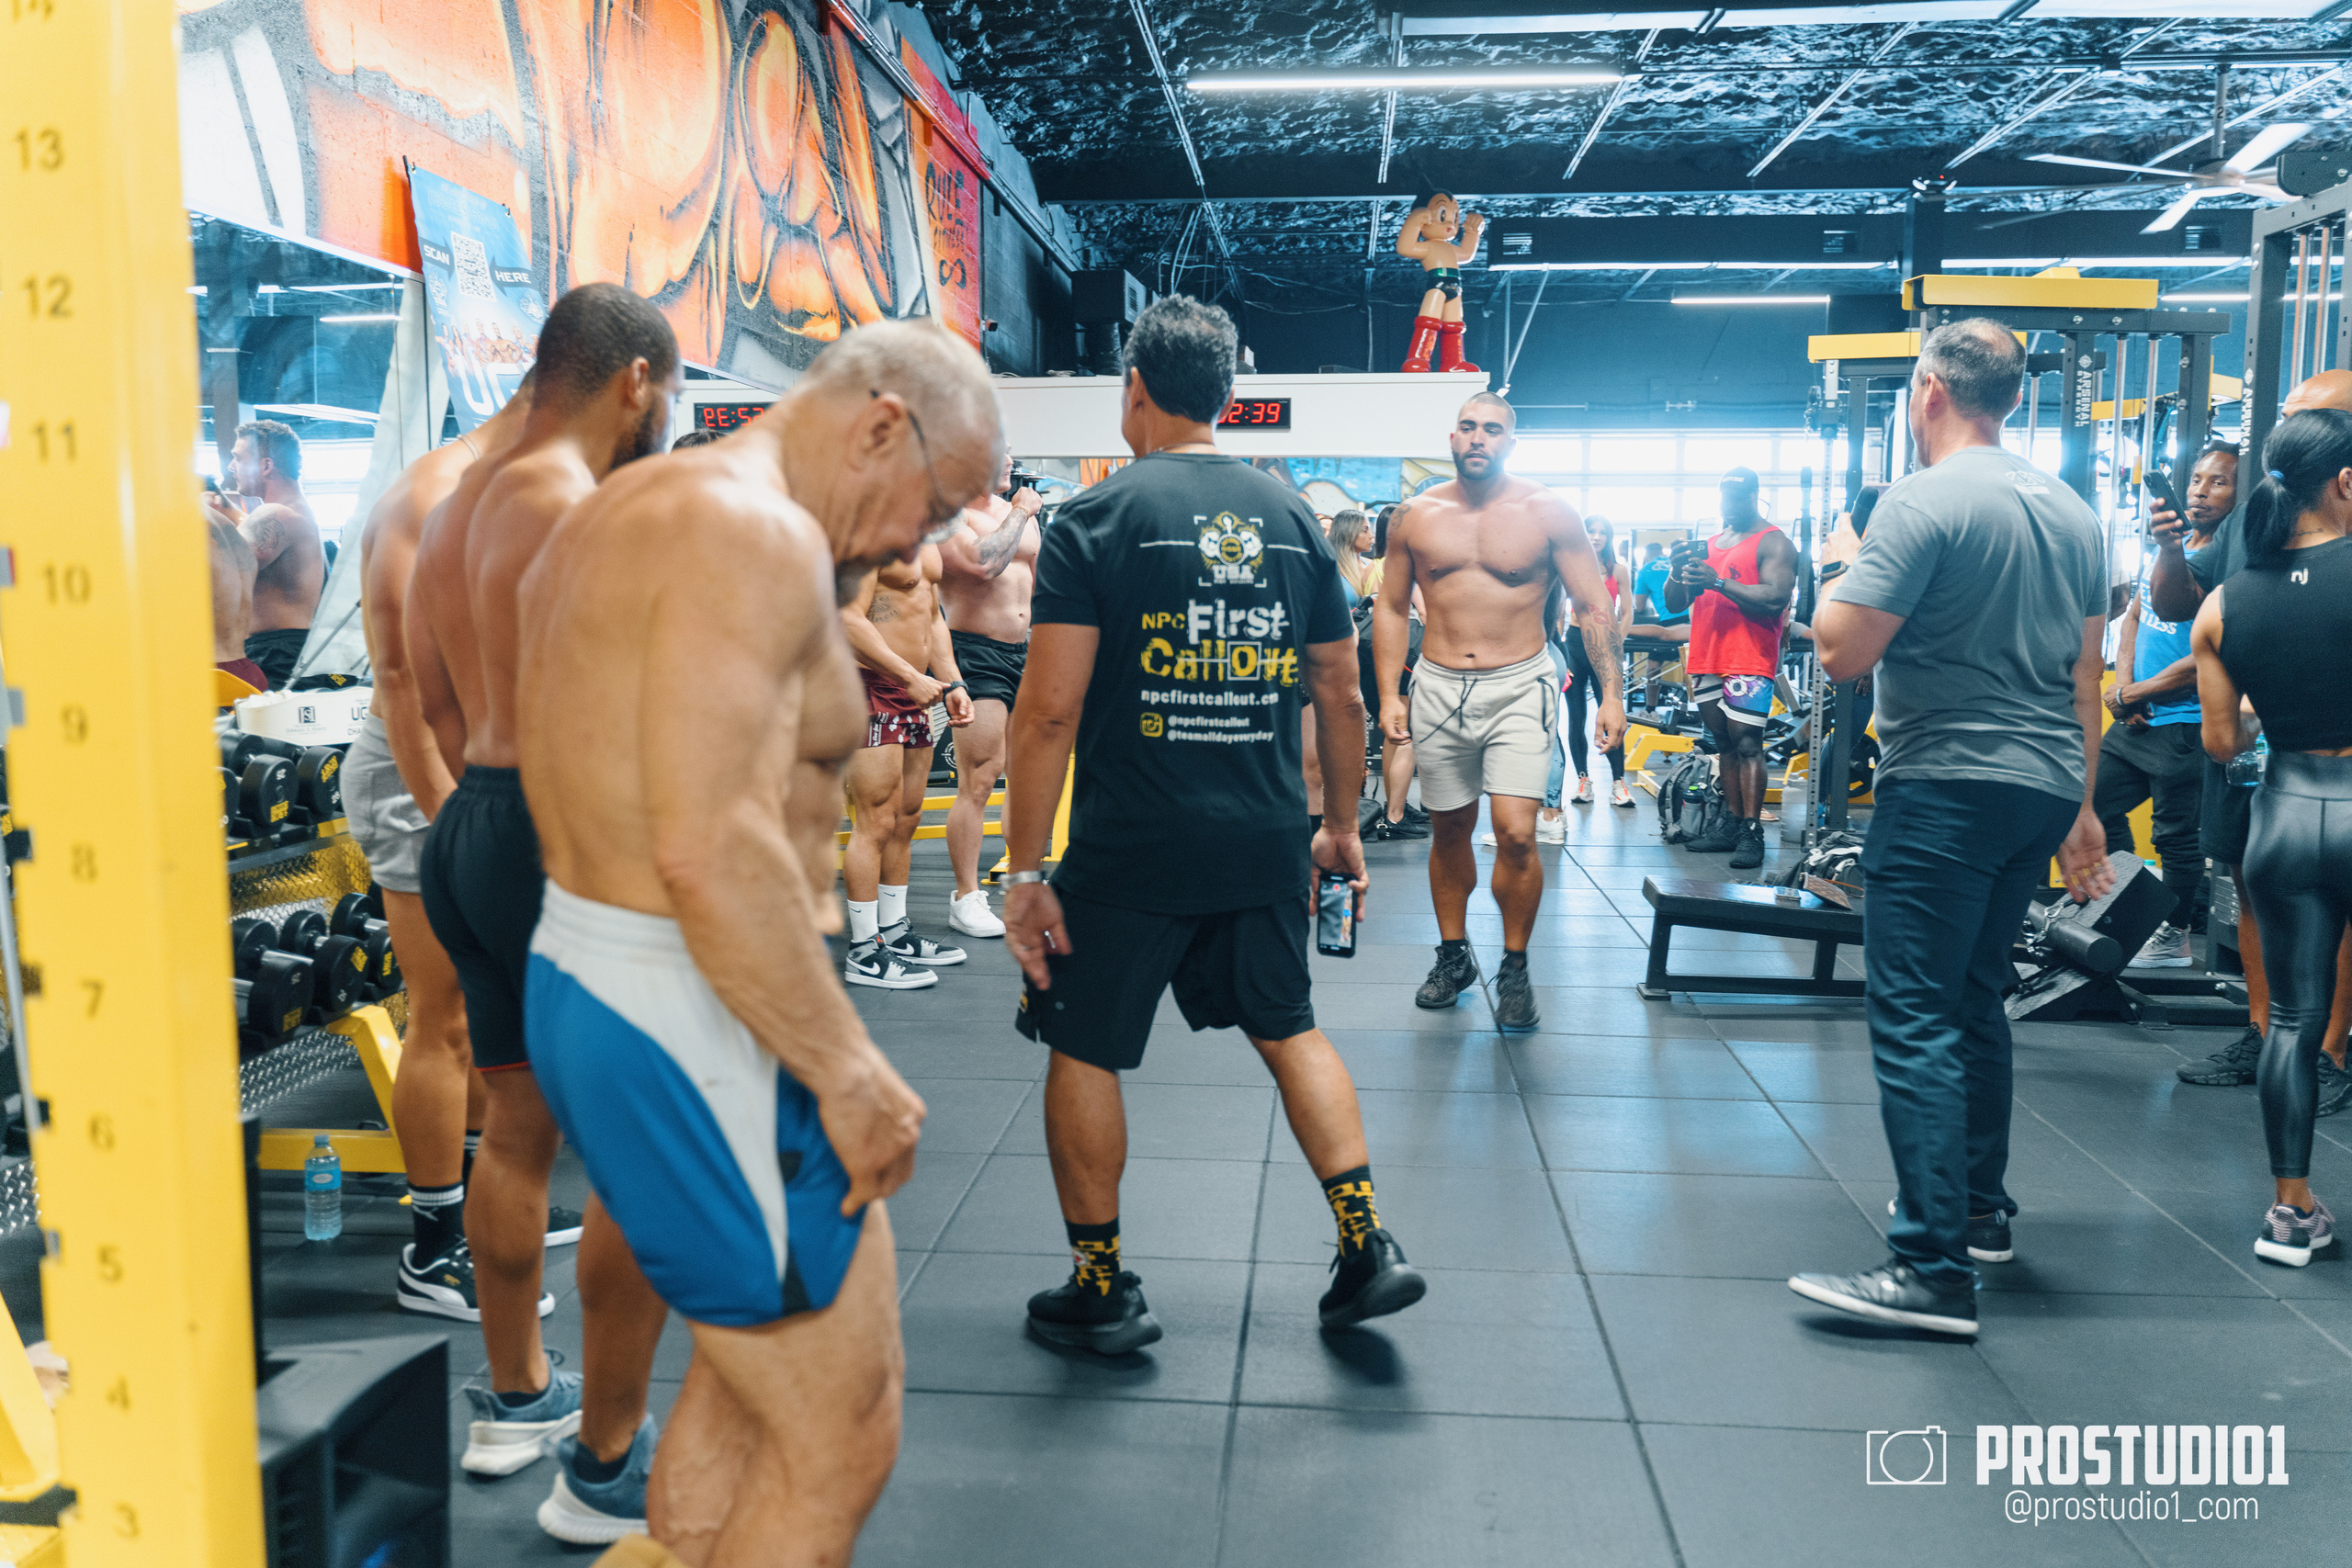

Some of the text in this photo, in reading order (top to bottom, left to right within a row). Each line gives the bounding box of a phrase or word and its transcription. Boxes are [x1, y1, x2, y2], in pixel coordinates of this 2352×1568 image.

[15, 126, 63, 170] 13
[424, 244, 450, 265] SCAN
[21, 274, 73, 318] 12
[494, 269, 532, 284] HERE
[1216, 402, 1281, 423] 2:39
[2080, 371, 2092, 426] ARSENAL
[32, 420, 75, 462] 11
[42, 564, 90, 606] 10
[1141, 599, 1290, 644] NPC First
[61, 704, 88, 745] 9
[71, 842, 97, 884] 8
[79, 977, 105, 1019] 7
[88, 1113, 115, 1153] 6
[97, 1244, 123, 1283] 5
[107, 1376, 131, 1411] 4
[114, 1502, 140, 1540] 3
